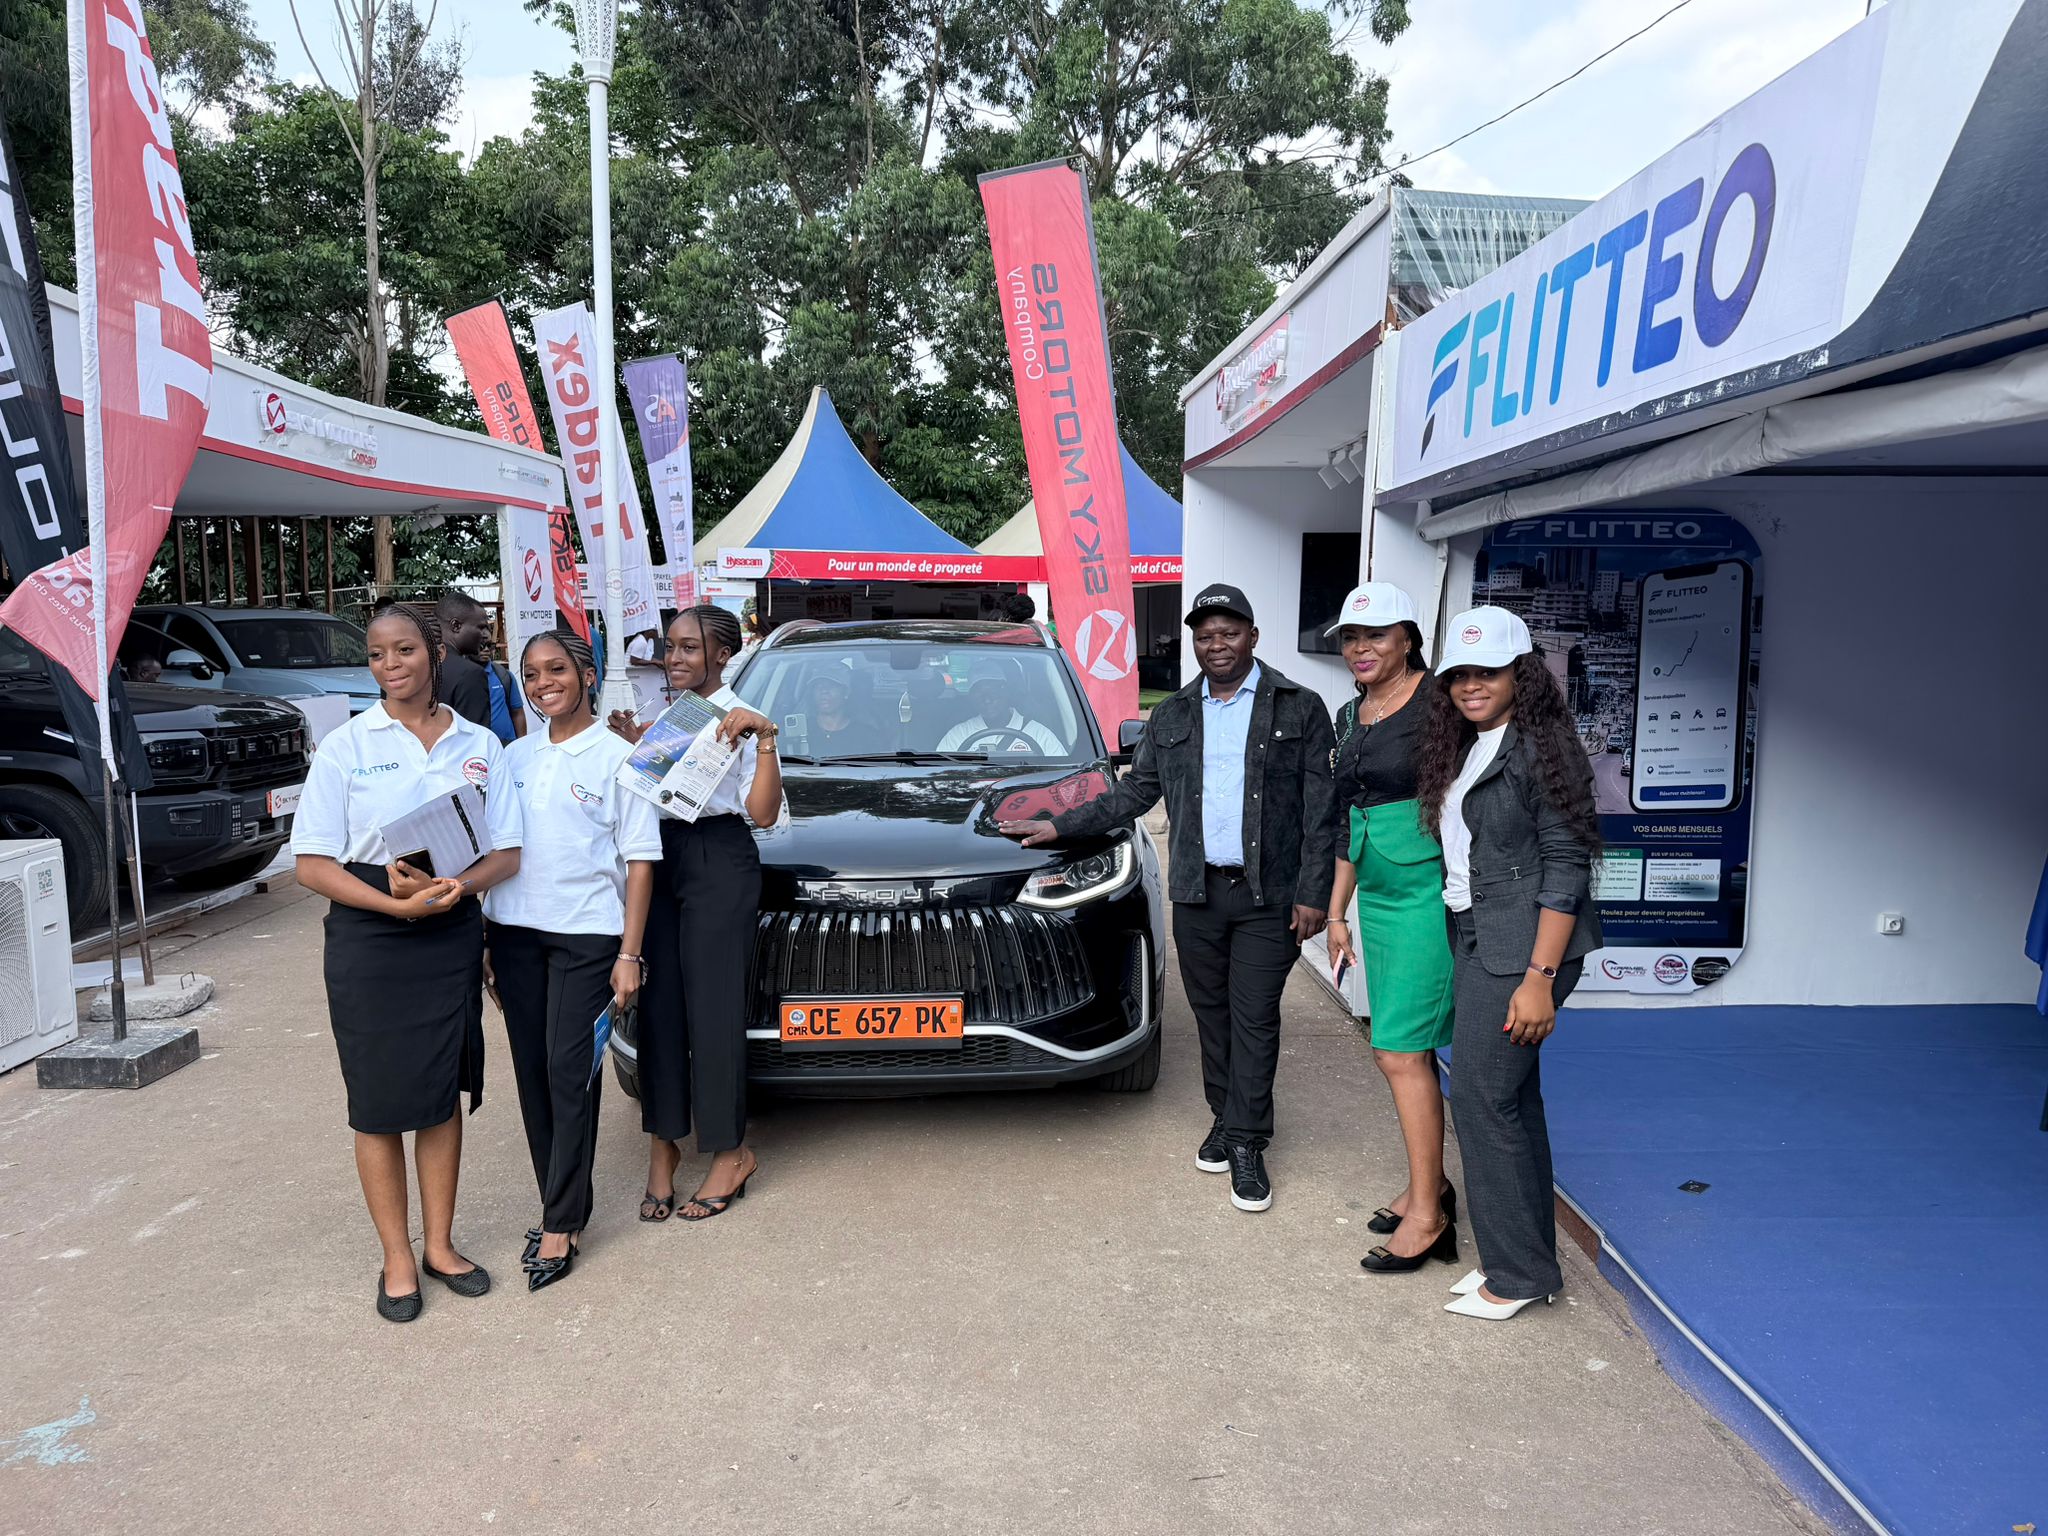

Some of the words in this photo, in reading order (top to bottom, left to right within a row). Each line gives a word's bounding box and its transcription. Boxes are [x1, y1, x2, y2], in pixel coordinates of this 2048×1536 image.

[105, 0, 213, 421] Trad
[1463, 142, 1776, 439] FLITTEO
[1544, 520, 1702, 540] FLITTEO
[723, 555, 763, 570] Hysacam
[827, 558, 856, 572] Pour
[859, 561, 874, 572] un
[875, 559, 916, 573] monde
[918, 559, 932, 573] de
[934, 559, 983, 576] propreté
[1130, 562, 1148, 574] orld
[1149, 562, 1161, 574] of
[1161, 562, 1182, 574] Clea
[656, 582, 673, 591] IBLE
[1666, 585, 1708, 598] FLITTEO
[520, 609, 530, 620] SKY
[530, 609, 553, 620] MOTORS
[1648, 607, 1674, 616] Bonjour
[358, 762, 399, 777] FLITTEO
[1633, 825, 1650, 833] VOS
[1651, 825, 1677, 833] GAINS
[1678, 825, 1723, 833] MENSUELS
[794, 887, 949, 901] JETOUR
[1667, 909, 1706, 917] propriétaire
[809, 1008, 842, 1035] CE
[855, 1007, 902, 1034] 657
[916, 1006, 947, 1034] PK
[787, 1026, 808, 1036] CMR
